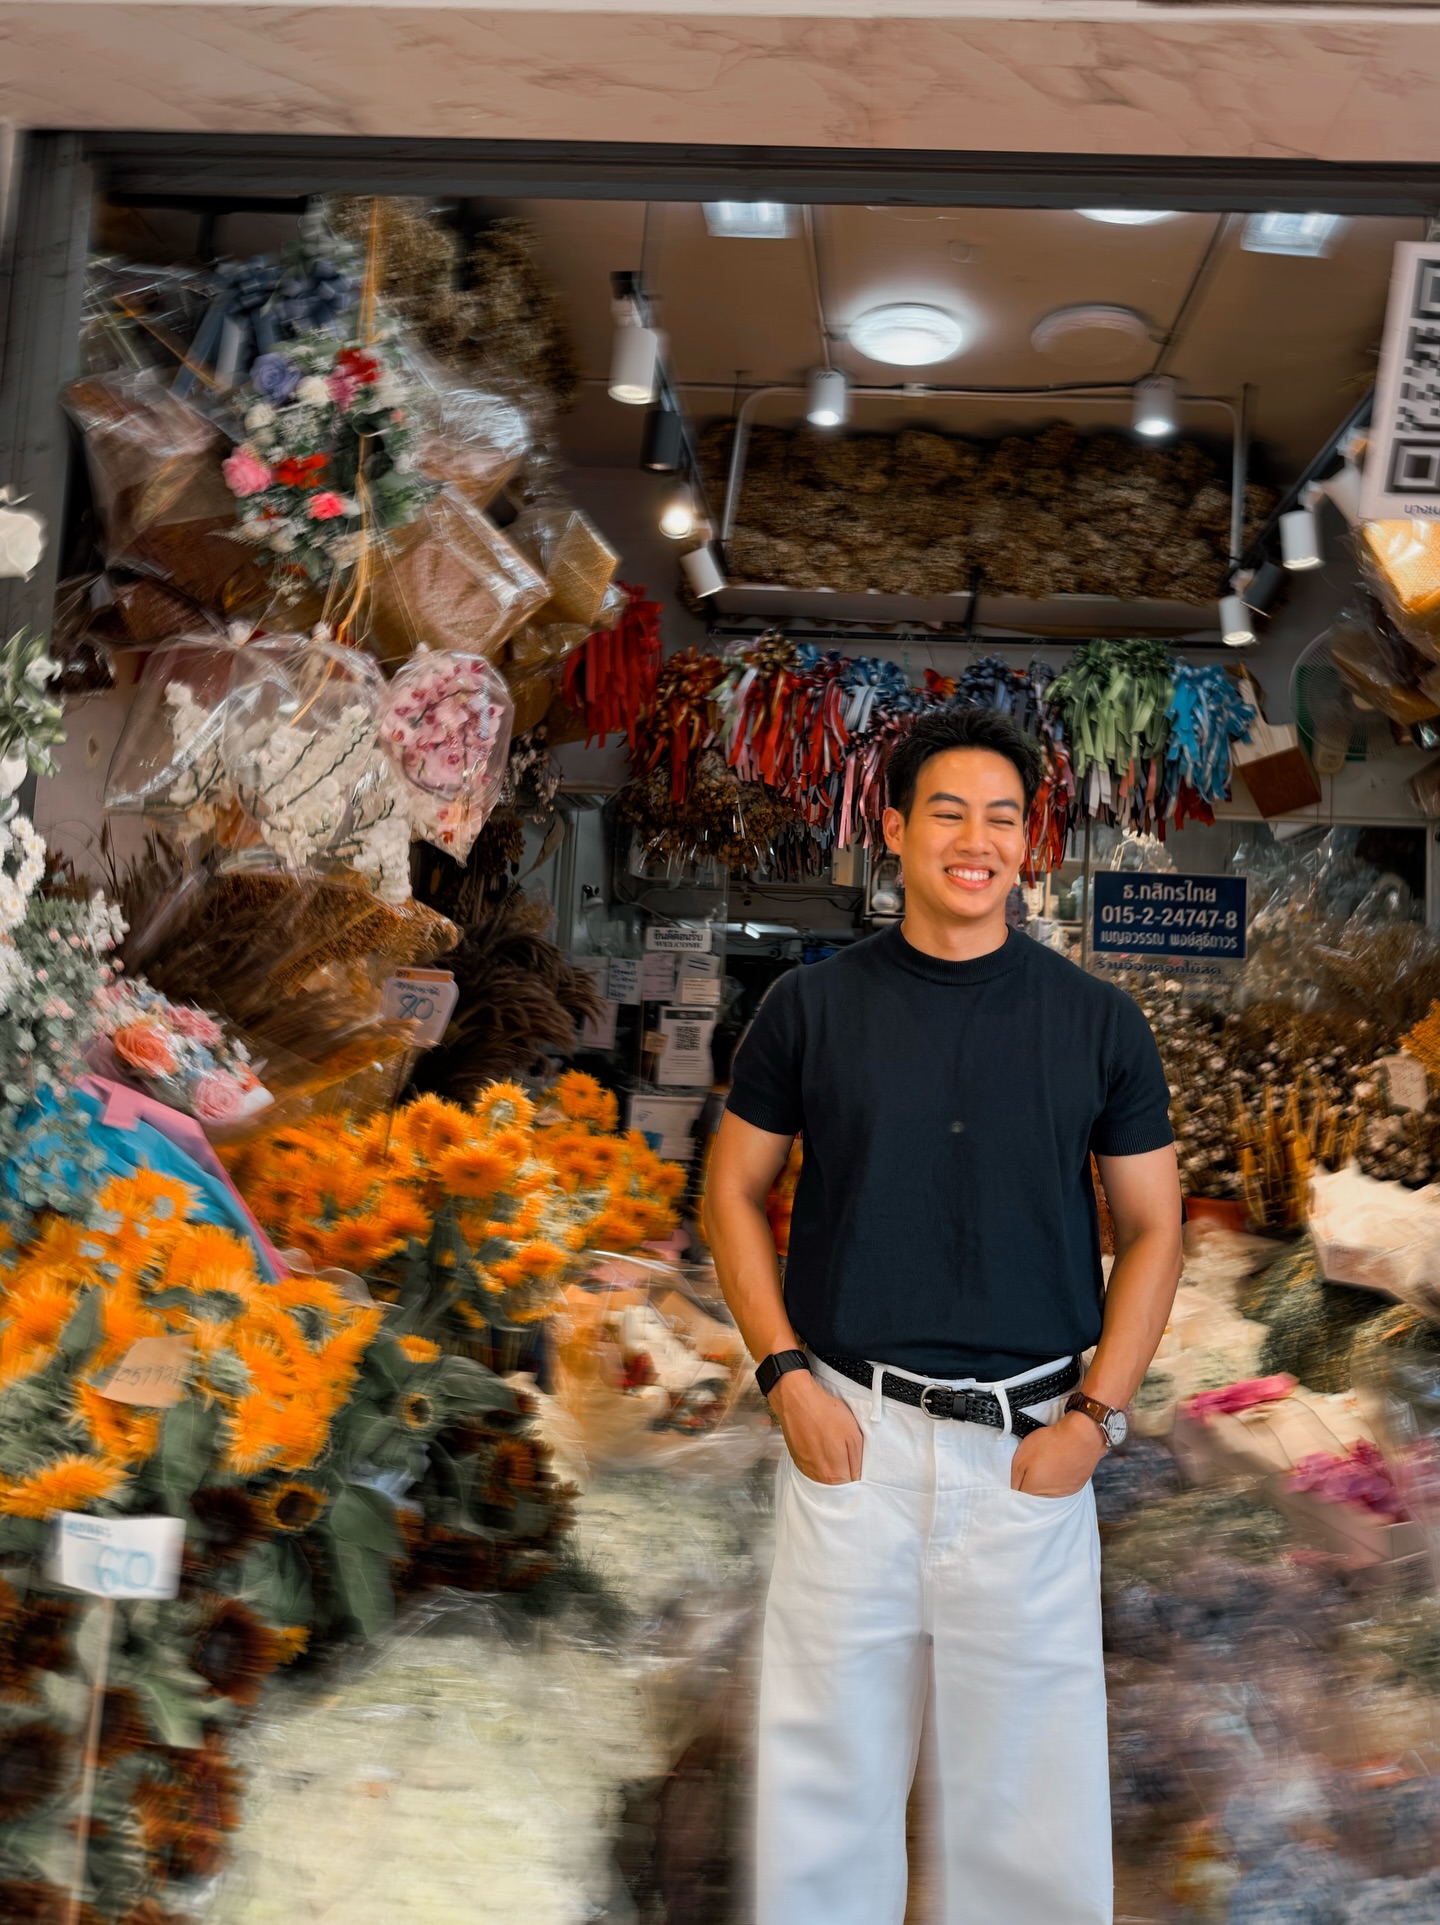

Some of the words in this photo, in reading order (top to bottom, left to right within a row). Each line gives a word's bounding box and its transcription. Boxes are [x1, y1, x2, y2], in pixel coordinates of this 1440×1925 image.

[1124, 881, 1216, 902] ธ.กสิกรไทย
[1102, 905, 1238, 929] 015-2-24747-8
[653, 929, 703, 942] ยินดีต้อนรับ
[1101, 931, 1164, 945] เบญจวรรณ
